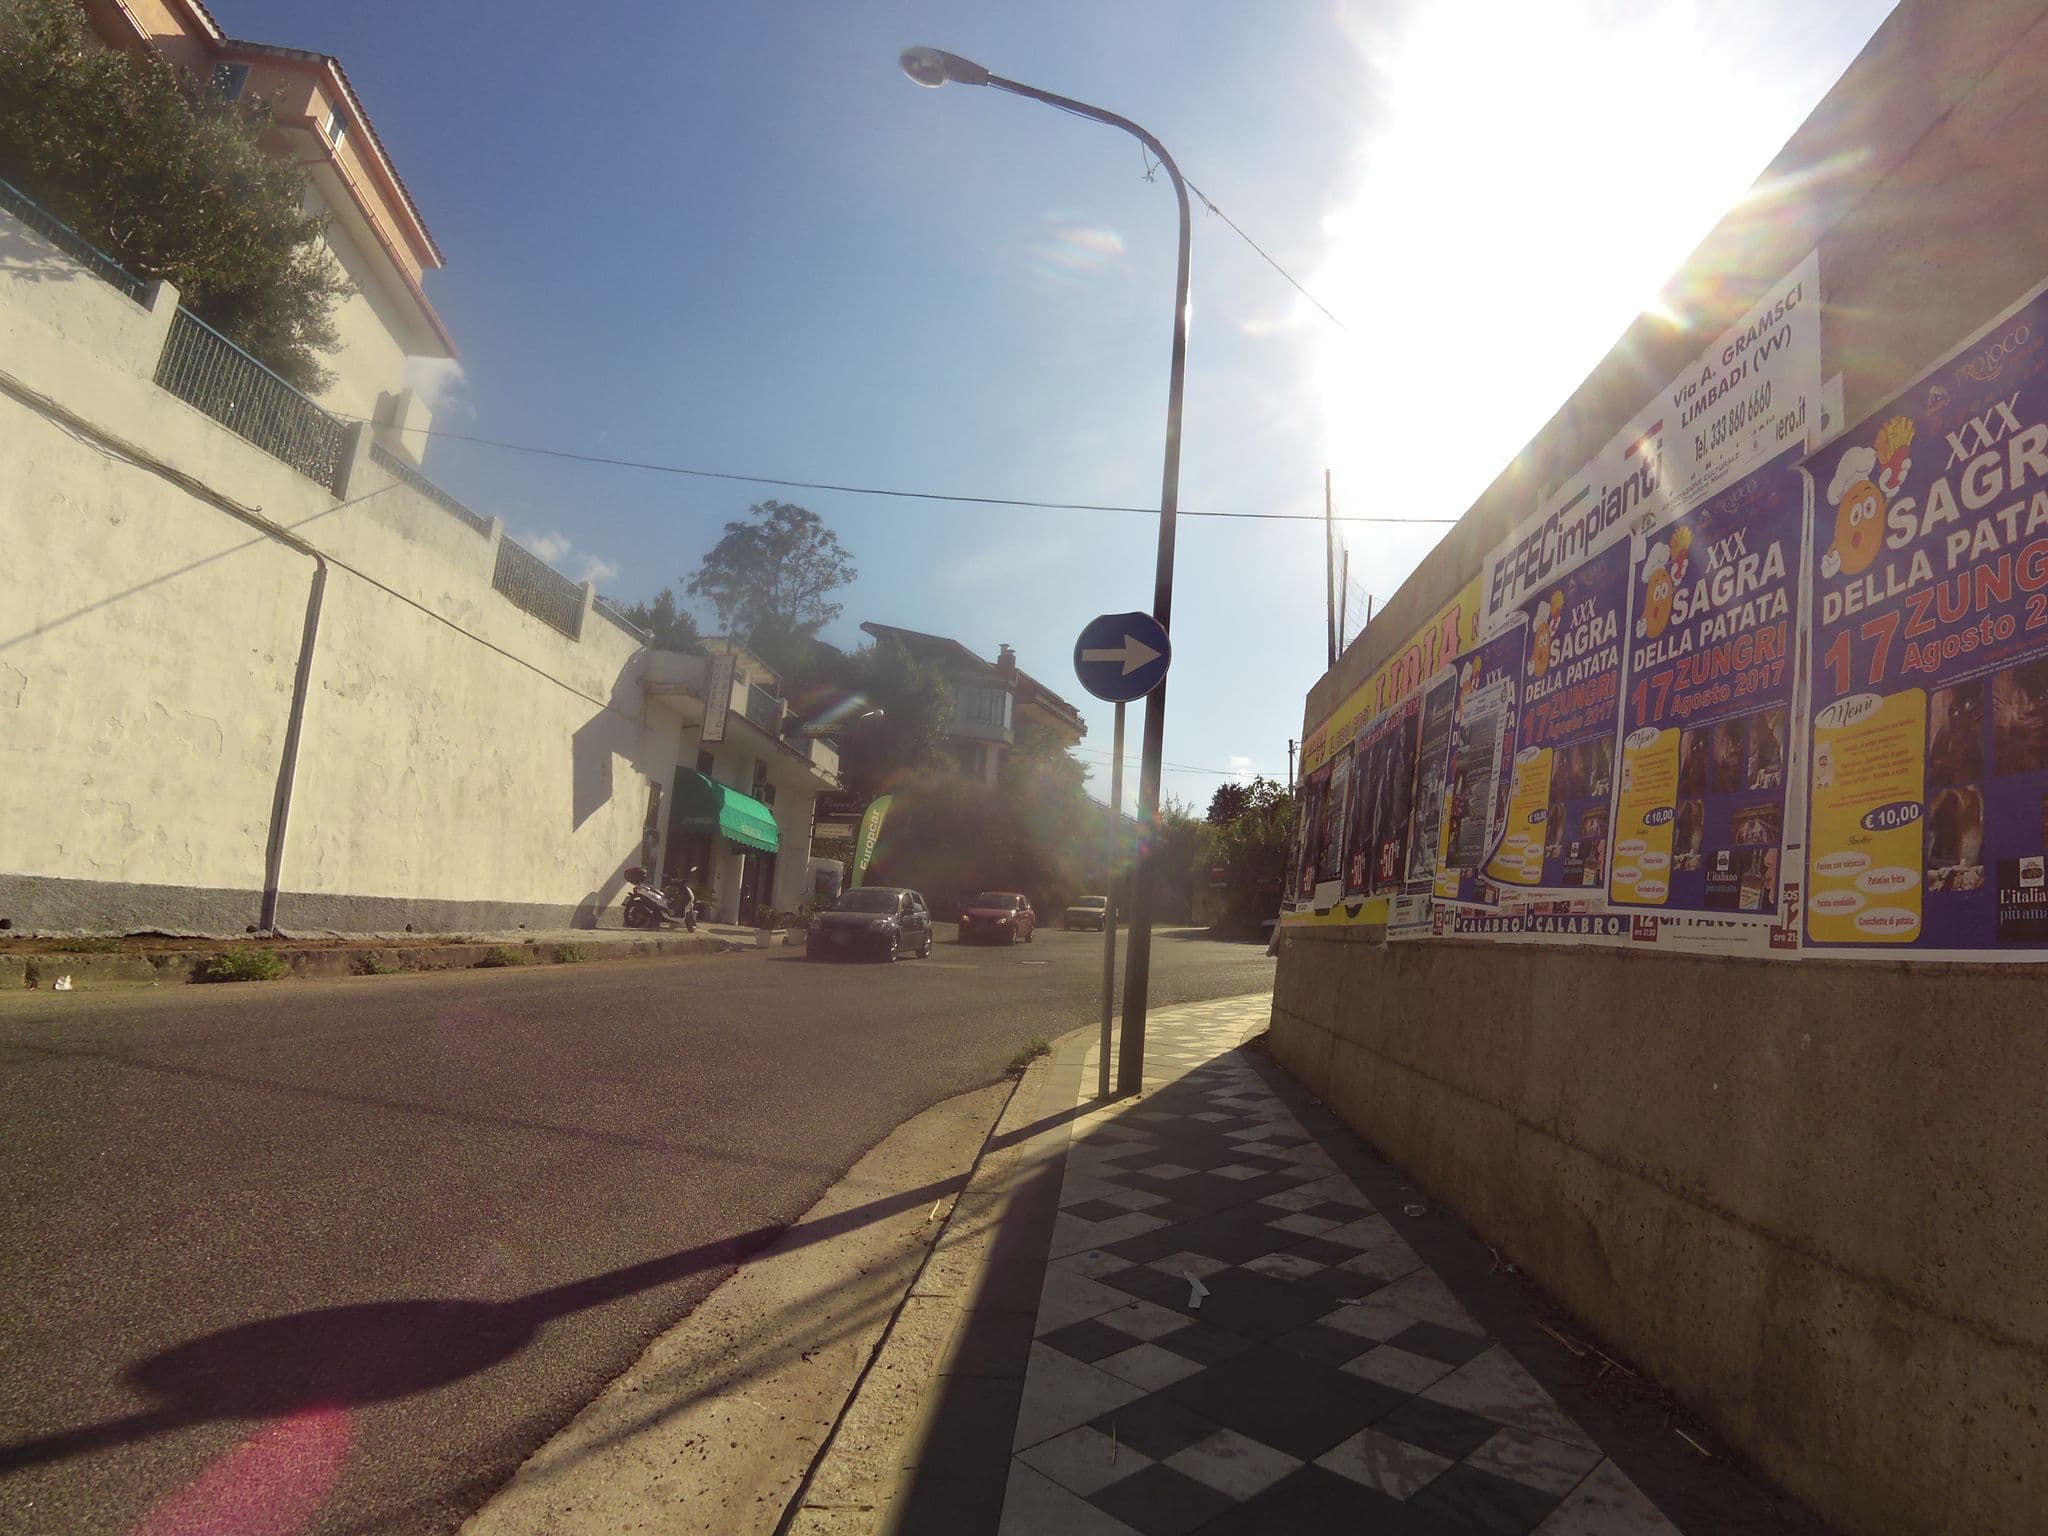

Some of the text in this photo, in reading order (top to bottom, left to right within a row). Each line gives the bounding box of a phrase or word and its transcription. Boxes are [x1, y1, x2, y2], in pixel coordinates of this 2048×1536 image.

[1673, 281, 1803, 409] Via A. GRAMSCI
[1681, 323, 1792, 430] LIMBADI (VV)
[1694, 379, 1773, 462] Tel. 333 860 6660
[1943, 389, 2023, 473] XXX
[1705, 526, 1748, 575] XXX
[1671, 540, 1786, 626] SAGRA
[1822, 548, 1934, 627] DELLA
[1549, 608, 1618, 668] SAGRA
[1633, 587, 1789, 673] DELLA PATATA
[1673, 619, 1787, 692] ZUNGRI
[1823, 610, 1900, 697] 17
[1899, 612, 2016, 675] Agosto
[1525, 669, 1562, 705] DELLA
[1566, 645, 1619, 687] PATATA
[1631, 668, 1674, 727] 17
[1669, 658, 1785, 717] Agosto 2017
[860, 808, 881, 871] Europcar
[1878, 802, 1920, 828] 10,00
[1462, 918, 1520, 932] CALABRO
[1536, 916, 1620, 935] CALABRO
